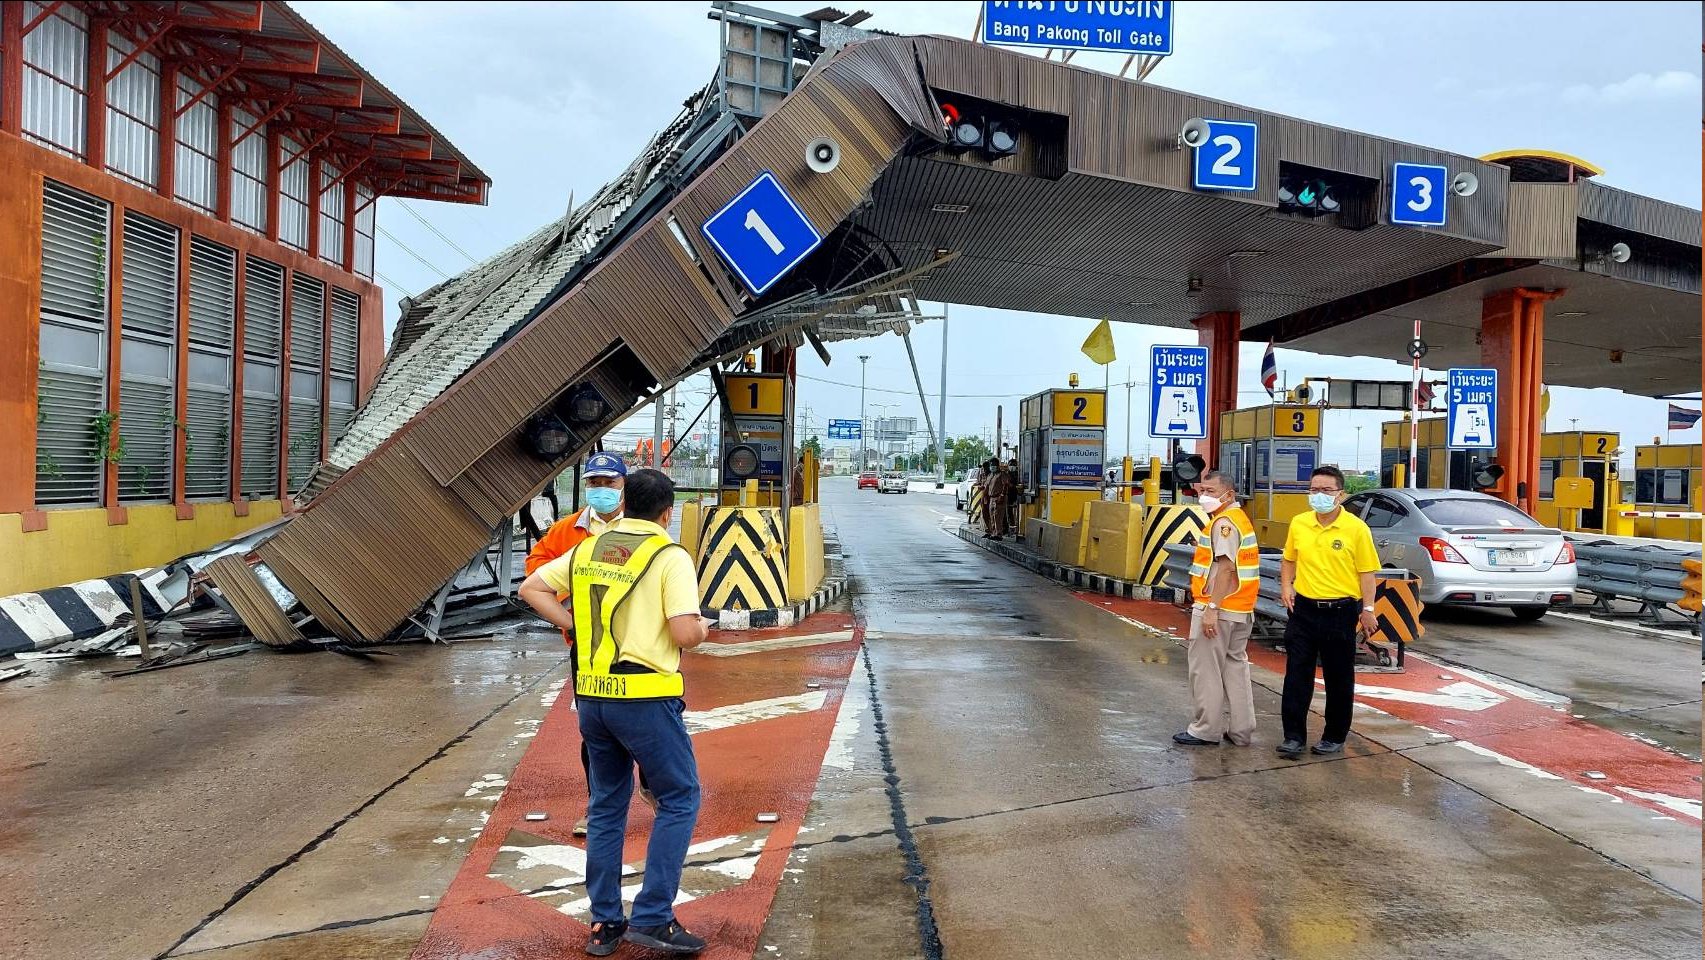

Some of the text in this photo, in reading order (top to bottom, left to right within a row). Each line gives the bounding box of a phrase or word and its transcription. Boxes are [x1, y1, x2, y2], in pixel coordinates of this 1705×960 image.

[994, 21, 1163, 47] Bang Pakong Toll Gate
[1211, 134, 1242, 176] 2
[1407, 176, 1433, 212] 3
[744, 208, 785, 255] 1
[1155, 349, 1204, 367] เว้นระยะ
[1157, 368, 1203, 386] 5 เมตร
[1452, 369, 1494, 387] เว้นระยะ
[747, 382, 759, 409] 1
[1453, 388, 1492, 403] 5 เมตร
[1073, 397, 1087, 420] 2
[1182, 402, 1188, 413] 5
[1292, 411, 1305, 432] 3
[1475, 417, 1480, 427] 5
[1597, 437, 1607, 455] 2
